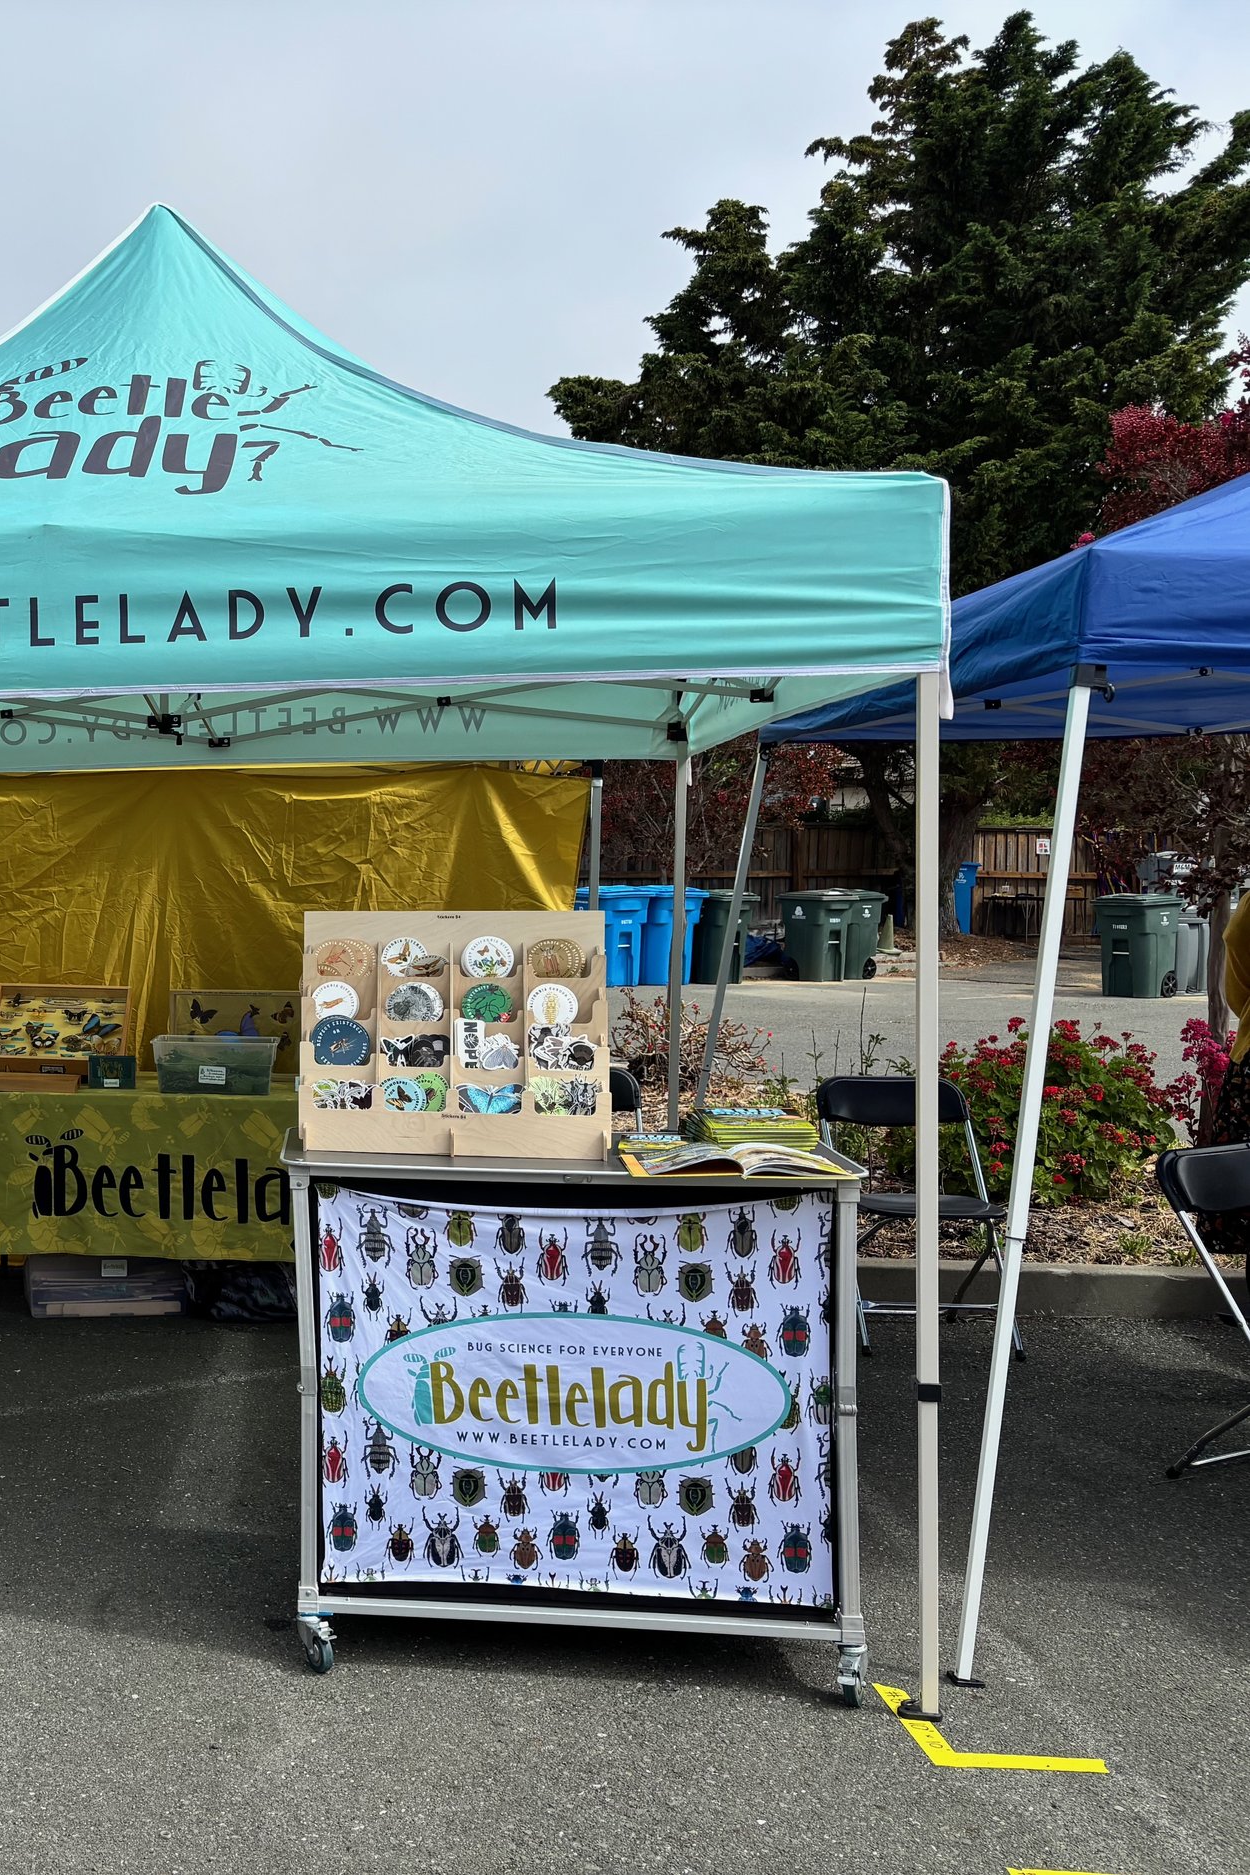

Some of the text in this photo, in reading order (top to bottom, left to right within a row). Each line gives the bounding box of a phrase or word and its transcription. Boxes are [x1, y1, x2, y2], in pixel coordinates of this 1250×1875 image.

[463, 1021, 480, 1069] NOPE
[53, 1143, 291, 1225] Beetlela
[467, 1342, 663, 1357] BUG SCIENCE FOR EVERYONE
[429, 1360, 708, 1452] Beetlelady
[456, 1431, 667, 1450] WWW.BEETLELADY.COM
